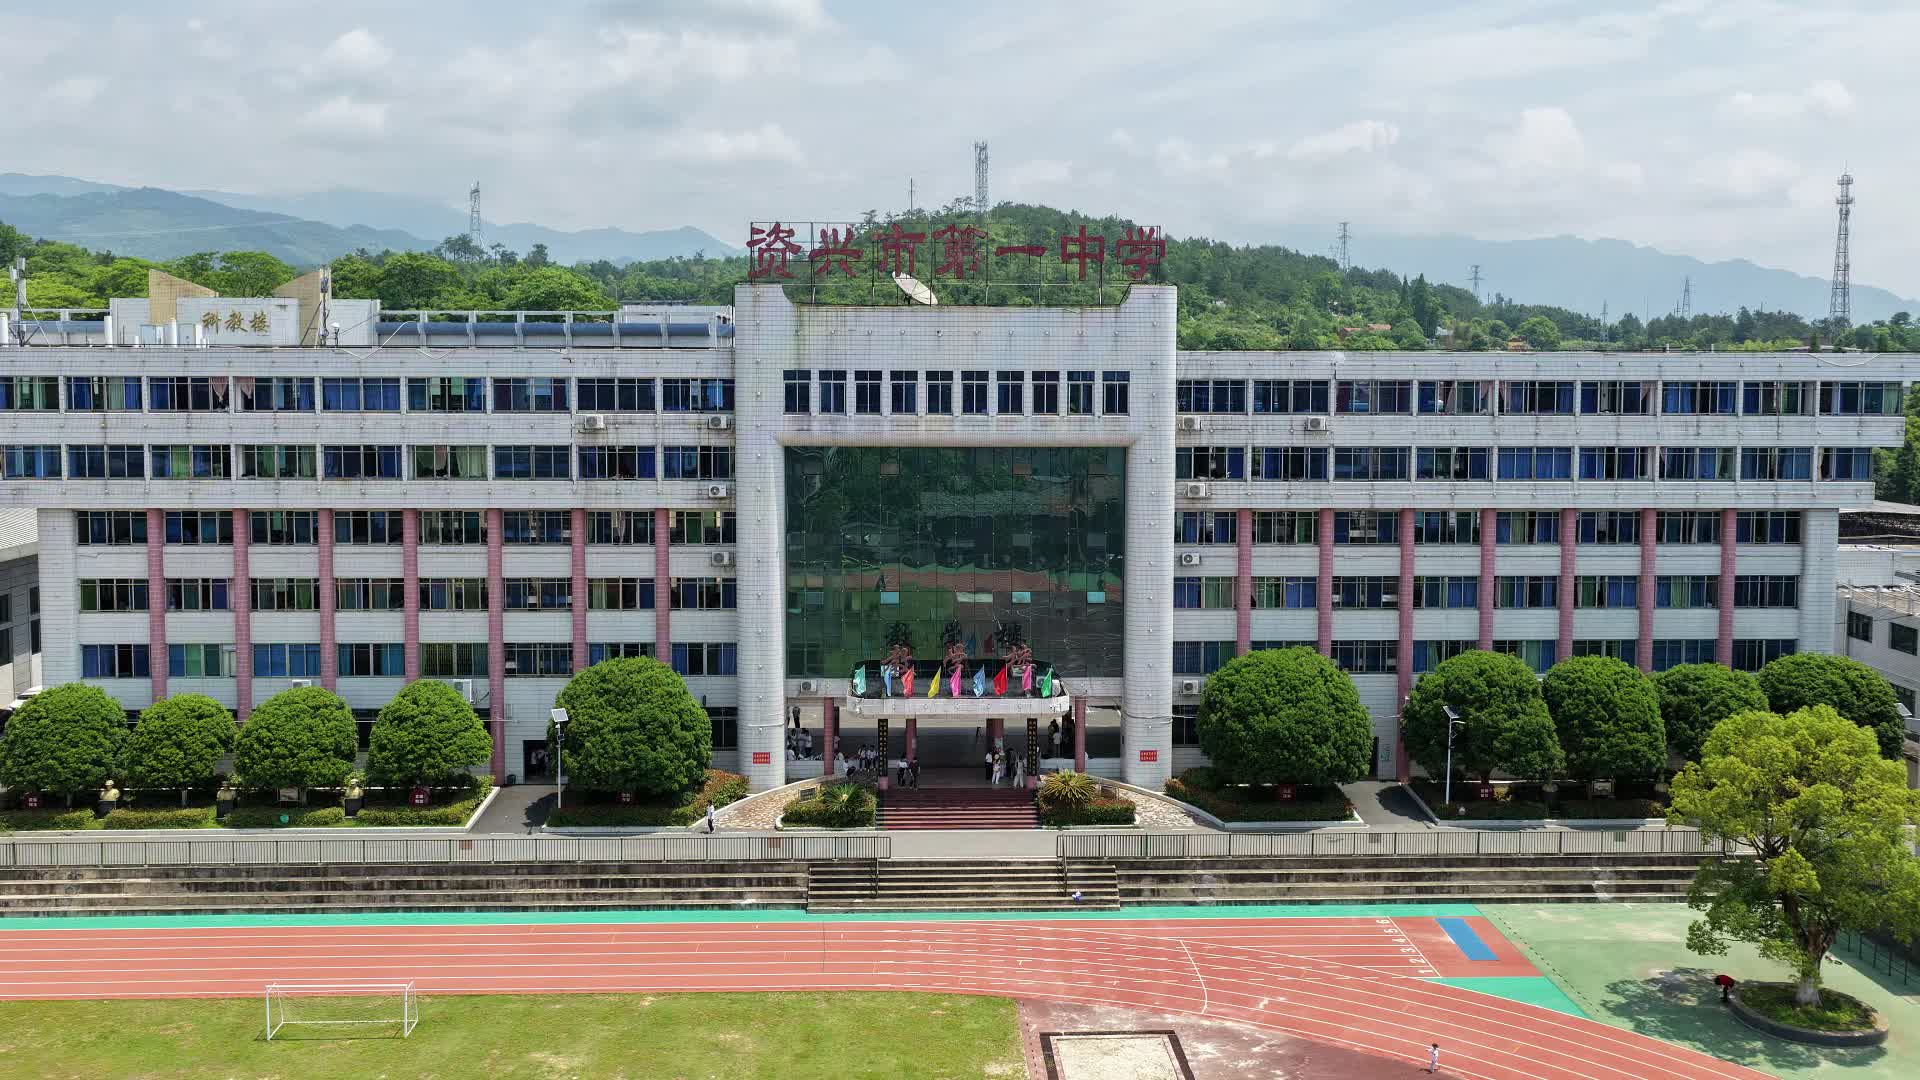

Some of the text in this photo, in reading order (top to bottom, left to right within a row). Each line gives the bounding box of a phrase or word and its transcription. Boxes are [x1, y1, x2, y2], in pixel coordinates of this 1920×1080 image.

[746, 222, 1166, 281] 资兴市第一中学
[202, 309, 270, 334] 科教楼
